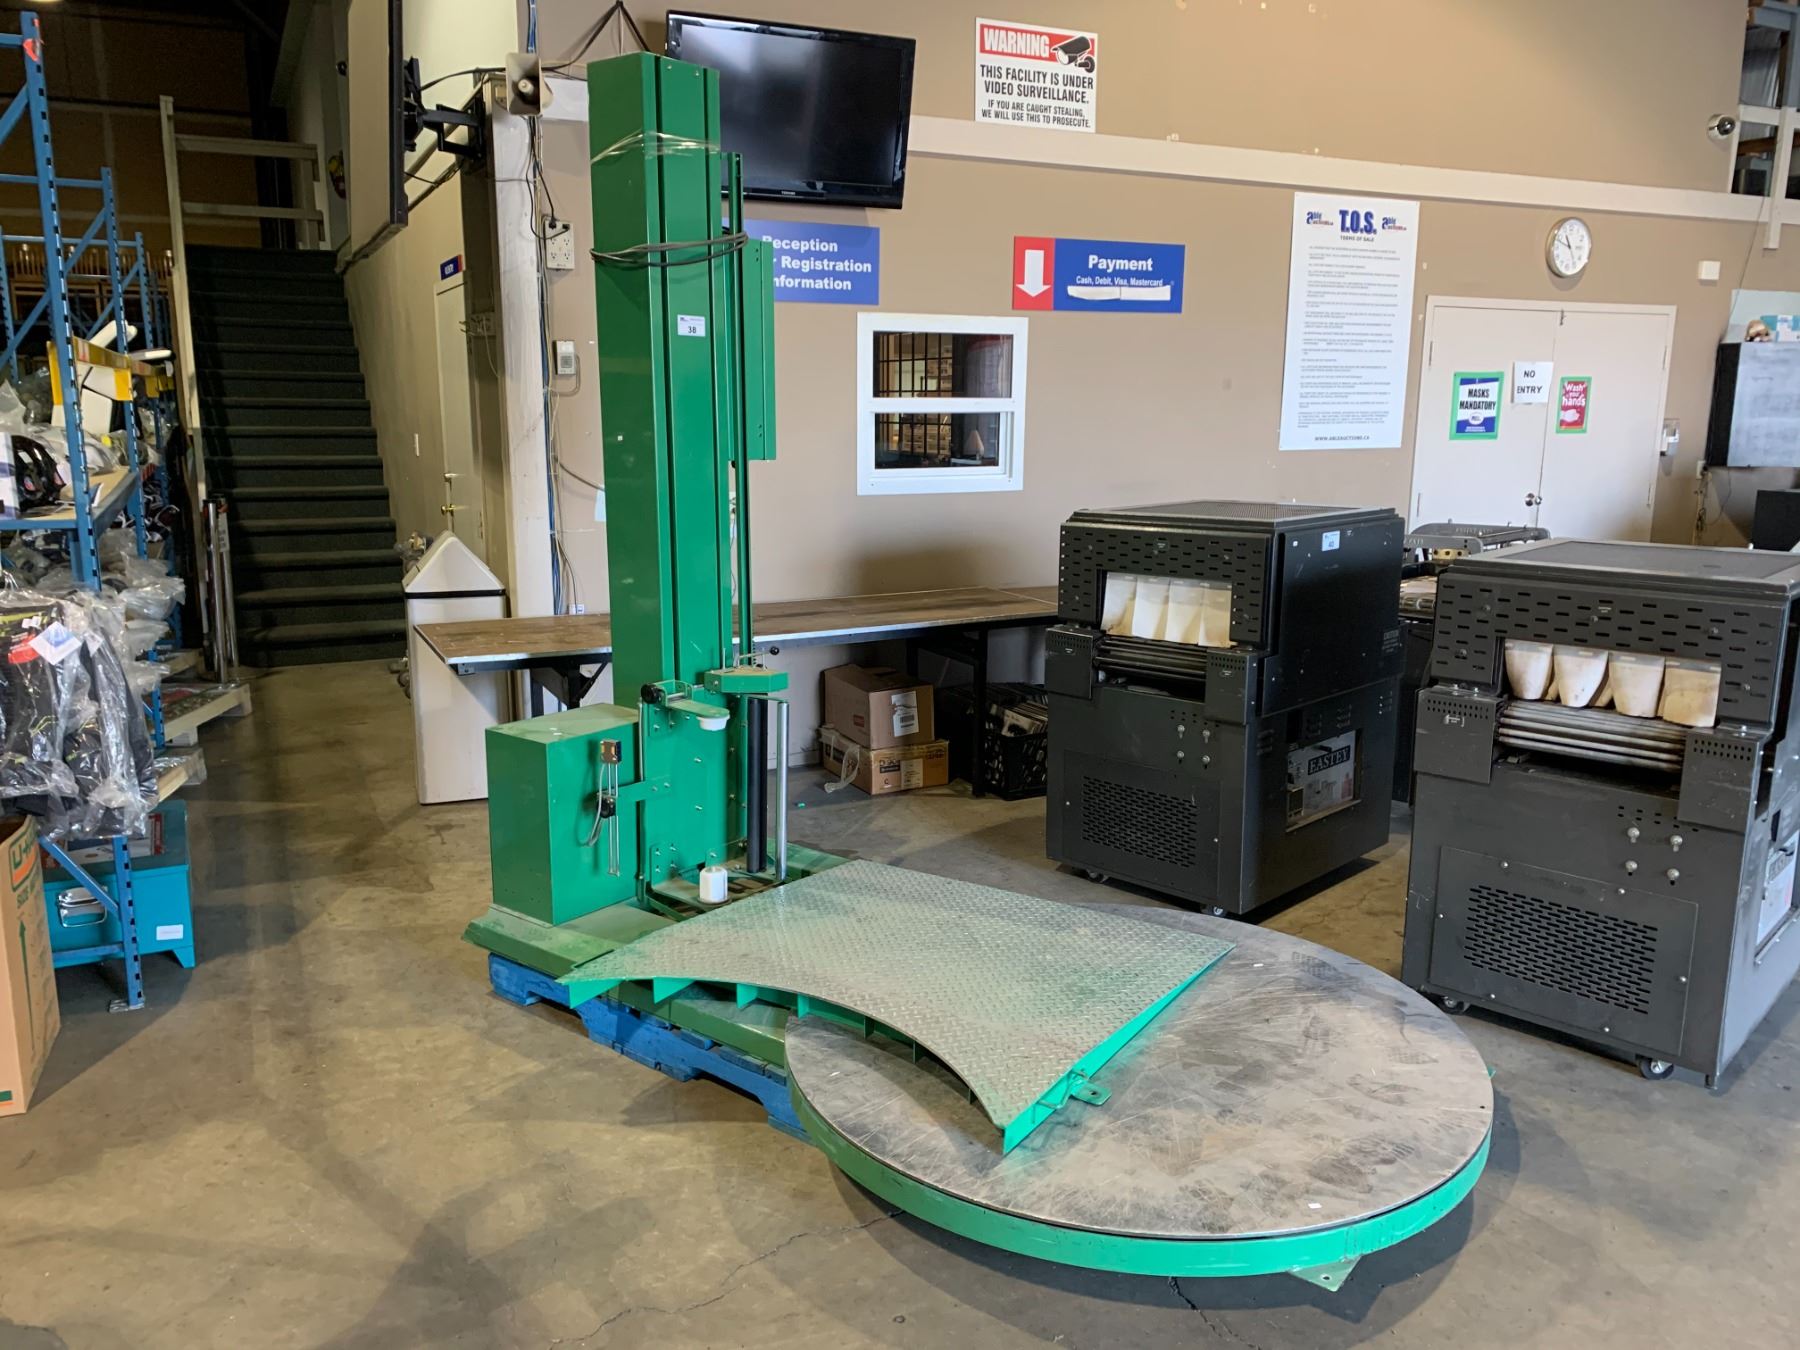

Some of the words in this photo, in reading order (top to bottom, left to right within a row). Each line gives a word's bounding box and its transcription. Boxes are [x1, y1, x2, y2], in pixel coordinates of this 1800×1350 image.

[983, 27, 1050, 58] WARNING
[980, 64, 1002, 79] THIS
[1006, 67, 1047, 83] FACILITY
[1050, 73, 1059, 85] IS
[1062, 74, 1093, 89] UNDER
[984, 80, 1013, 95] VIDEO
[1017, 85, 1089, 104] SURVEILLANCE.
[988, 99, 994, 108] IF
[996, 101, 1010, 110] YOU
[1011, 102, 1024, 111] ARE
[1026, 103, 1051, 114] CAUGHT
[1053, 106, 1085, 119] STEALING,
[981, 109, 992, 118] WE
[994, 110, 1010, 120] WILL
[1011, 112, 1024, 121] USE
[1026, 113, 1040, 123] THIS
[1042, 115, 1051, 124] TO
[1052, 116, 1091, 128] PROSECUTE.
[1339, 209, 1377, 235] T.O.S.
[781, 255, 872, 273] Registration
[1087, 254, 1154, 273] Payment
[774, 274, 852, 291] nformation
[1076, 275, 1094, 285] Cash,
[1114, 277, 1129, 286] Visa,
[1130, 277, 1163, 286] Mastercard
[1523, 370, 1536, 378] NO
[1468, 388, 1489, 398] MASKS
[1516, 385, 1543, 394] ENTRY
[1459, 400, 1496, 410] MANDATORY
